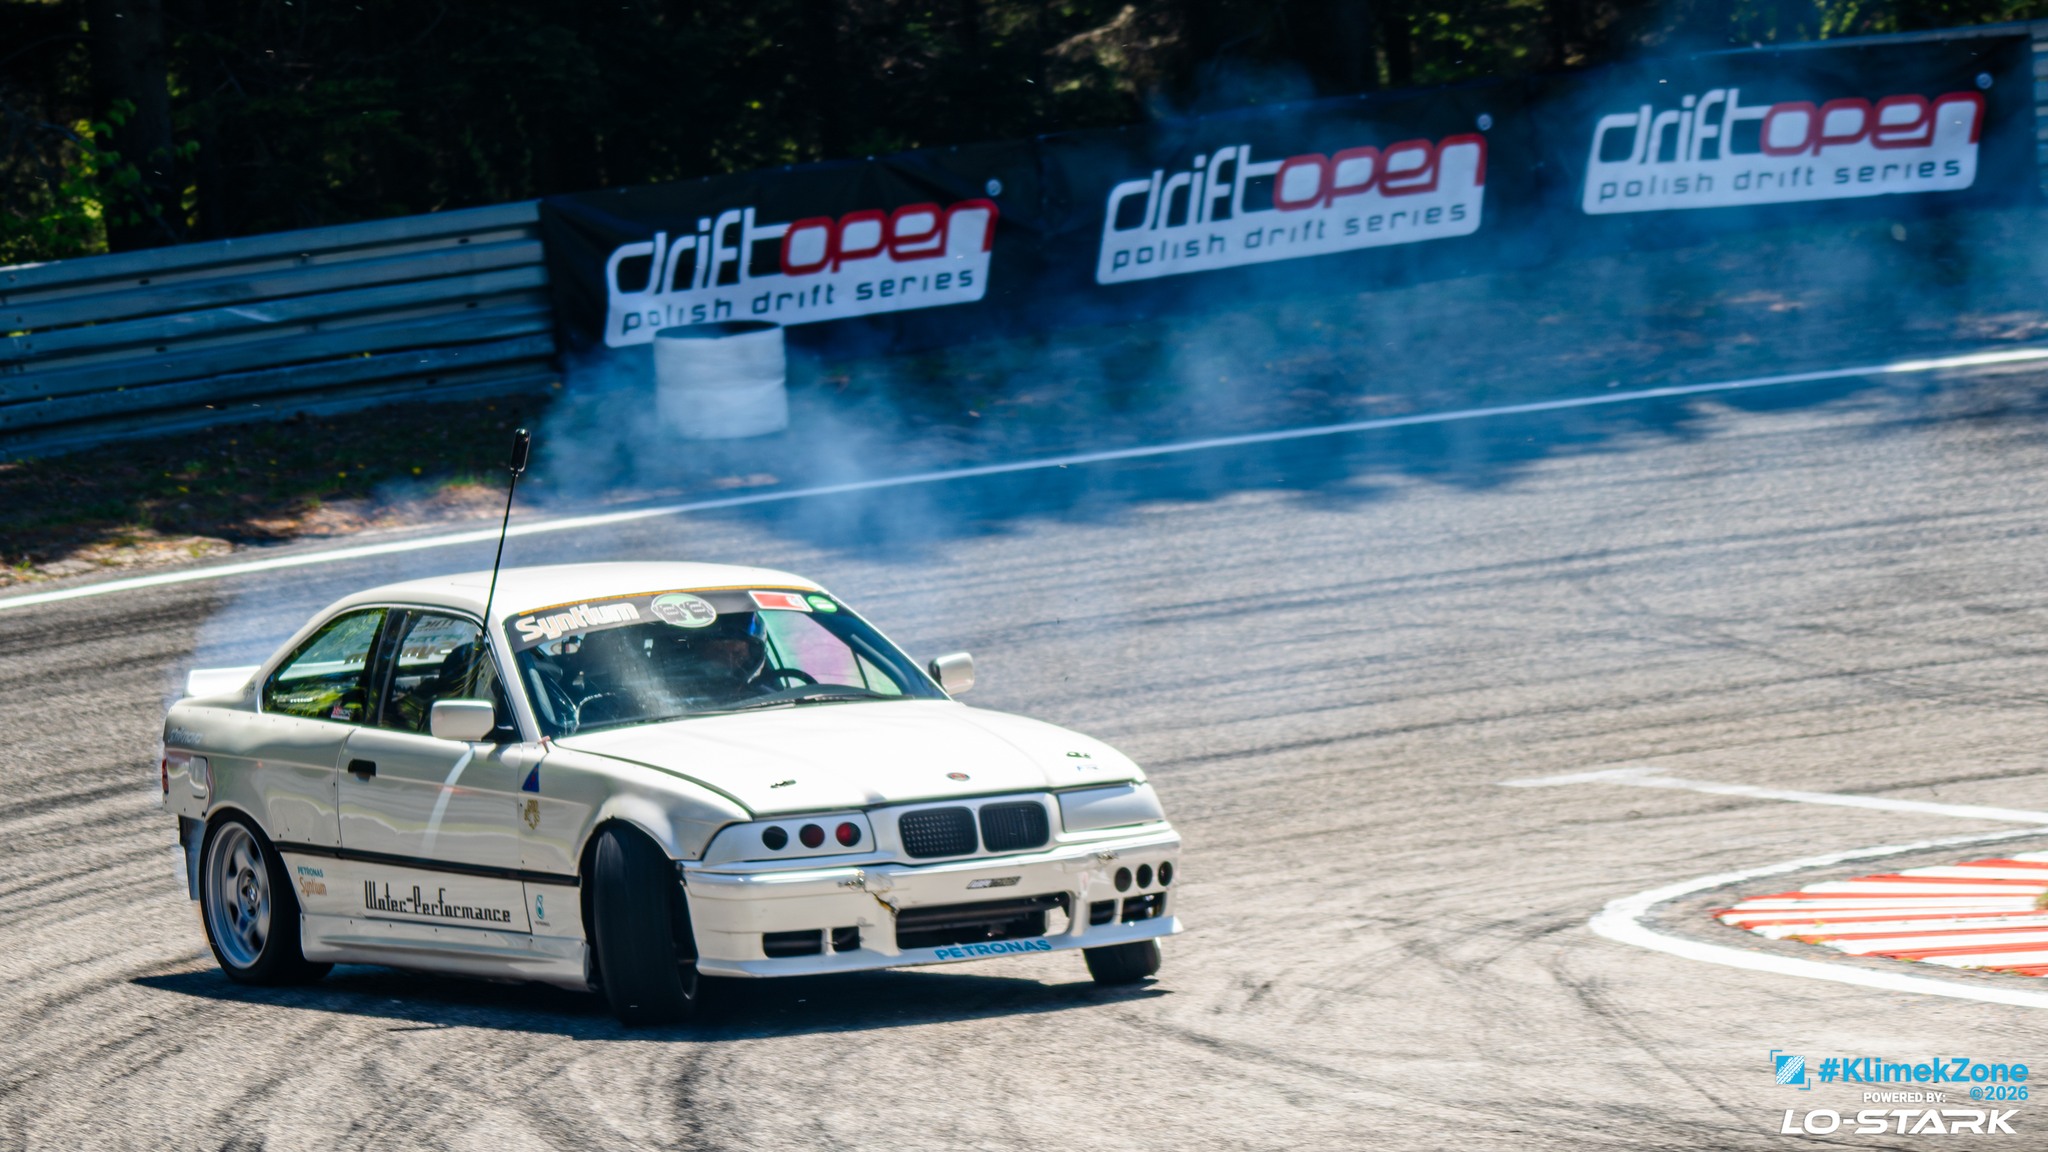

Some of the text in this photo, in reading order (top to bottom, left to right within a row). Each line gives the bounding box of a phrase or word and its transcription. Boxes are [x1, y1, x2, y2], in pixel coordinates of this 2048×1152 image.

[1599, 158, 1961, 205] polish drift series
[1111, 202, 1468, 273] polish drift series
[621, 268, 974, 336] polish drift series
[933, 939, 1053, 961] PETRONAS
